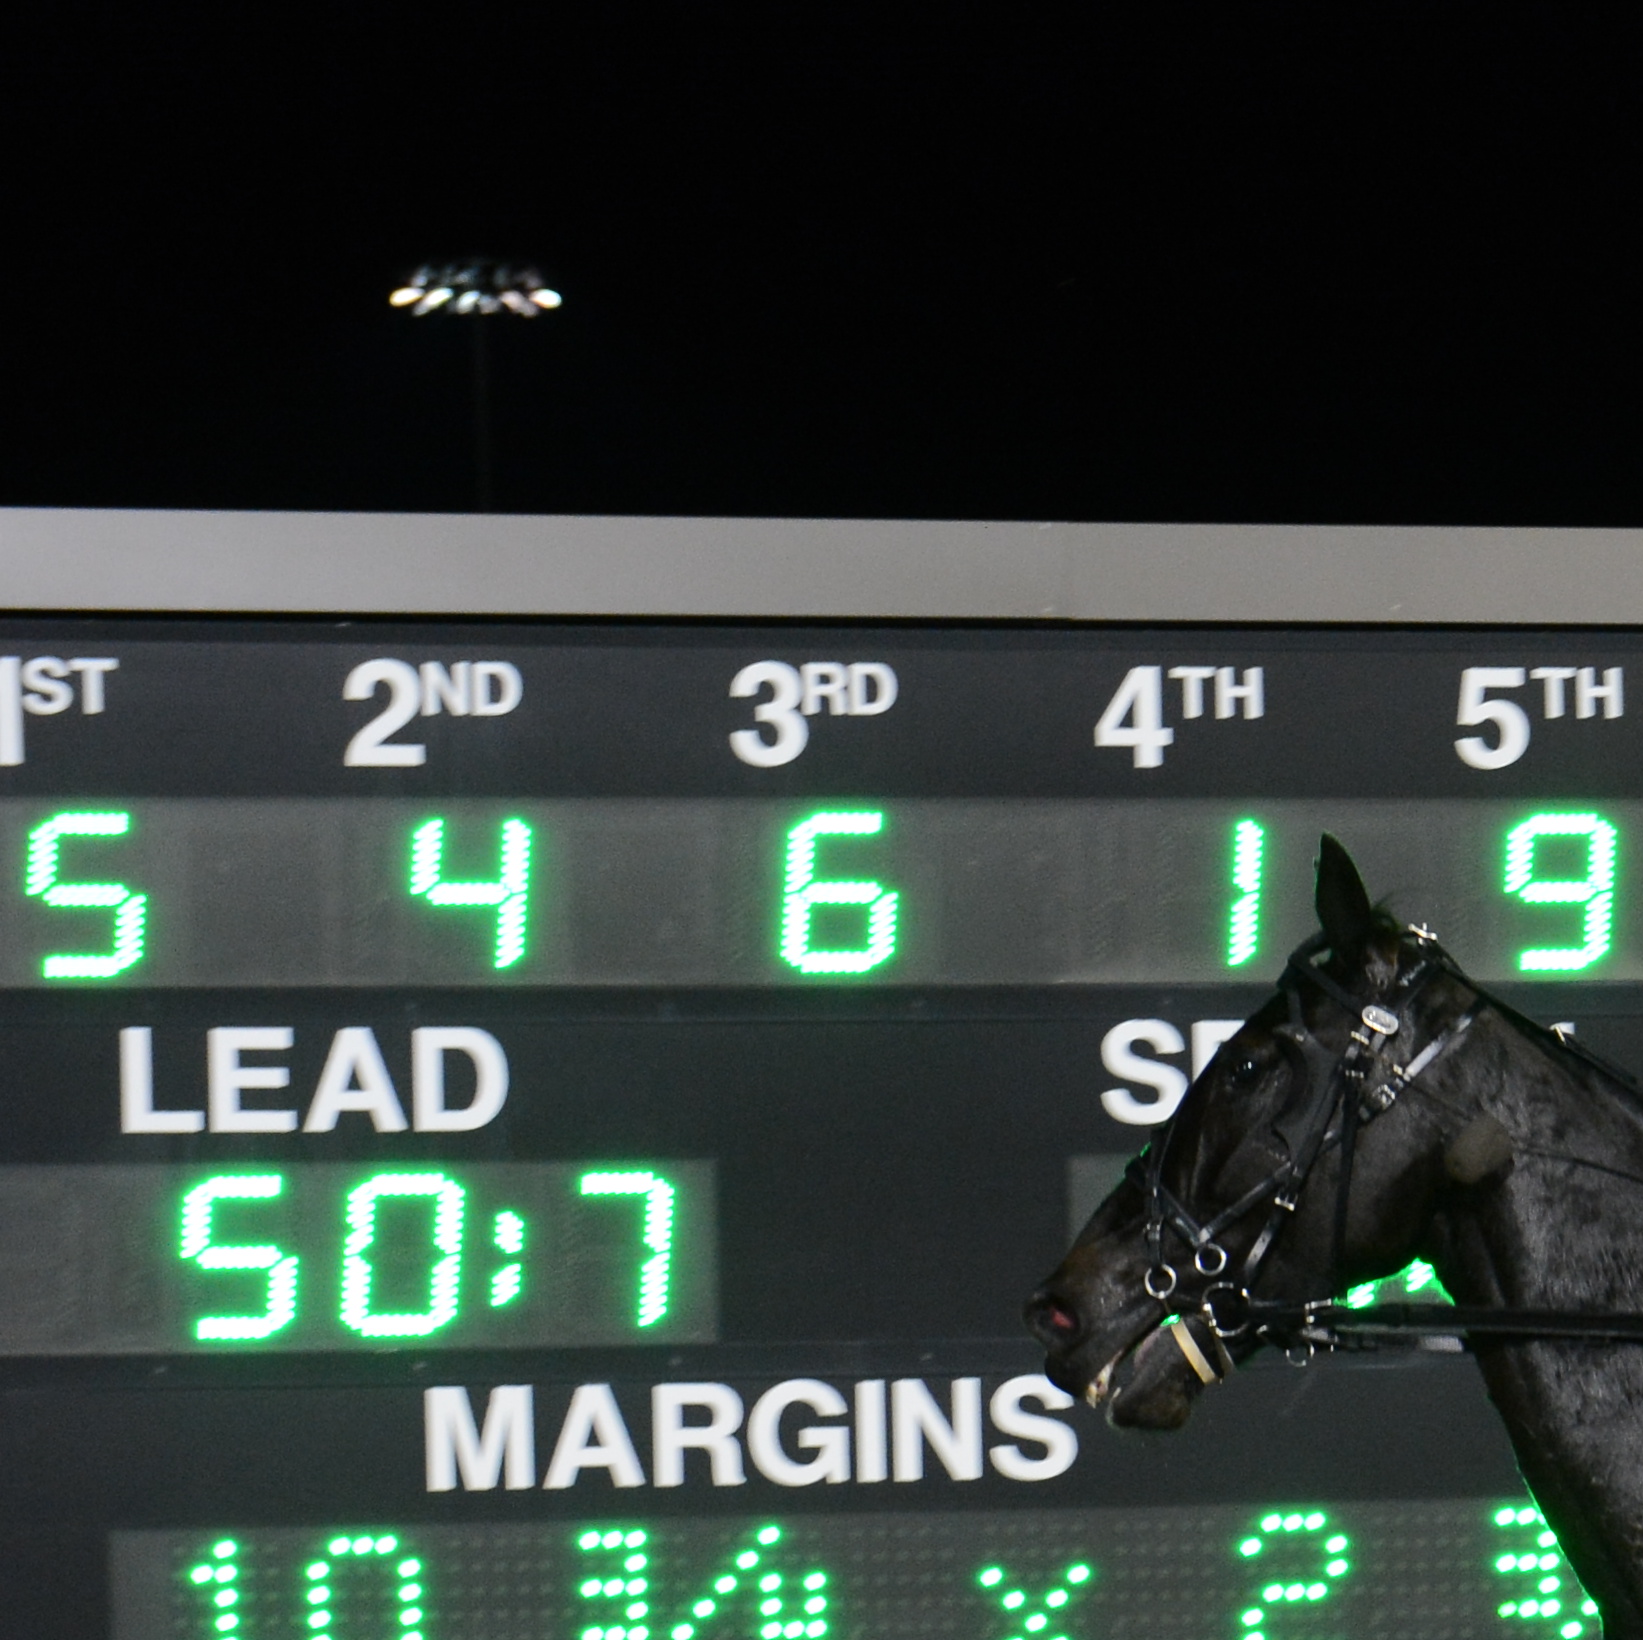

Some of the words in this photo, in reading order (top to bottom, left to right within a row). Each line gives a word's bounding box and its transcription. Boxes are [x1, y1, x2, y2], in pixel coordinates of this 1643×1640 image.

[344, 659, 521, 766] 2ND
[730, 661, 897, 767] 3RD
[1096, 666, 1263, 768] 4TH
[1455, 667, 1623, 769] 5TH
[26, 812, 147, 978] 5
[408, 819, 534, 967] 4
[778, 810, 899, 975] 6
[1227, 820, 1265, 965] 1
[1502, 812, 1618, 976] 9
[121, 1027, 508, 1133] LEAD
[177, 1170, 677, 1343] 50:7
[425, 1375, 1077, 1491] MARGINS
